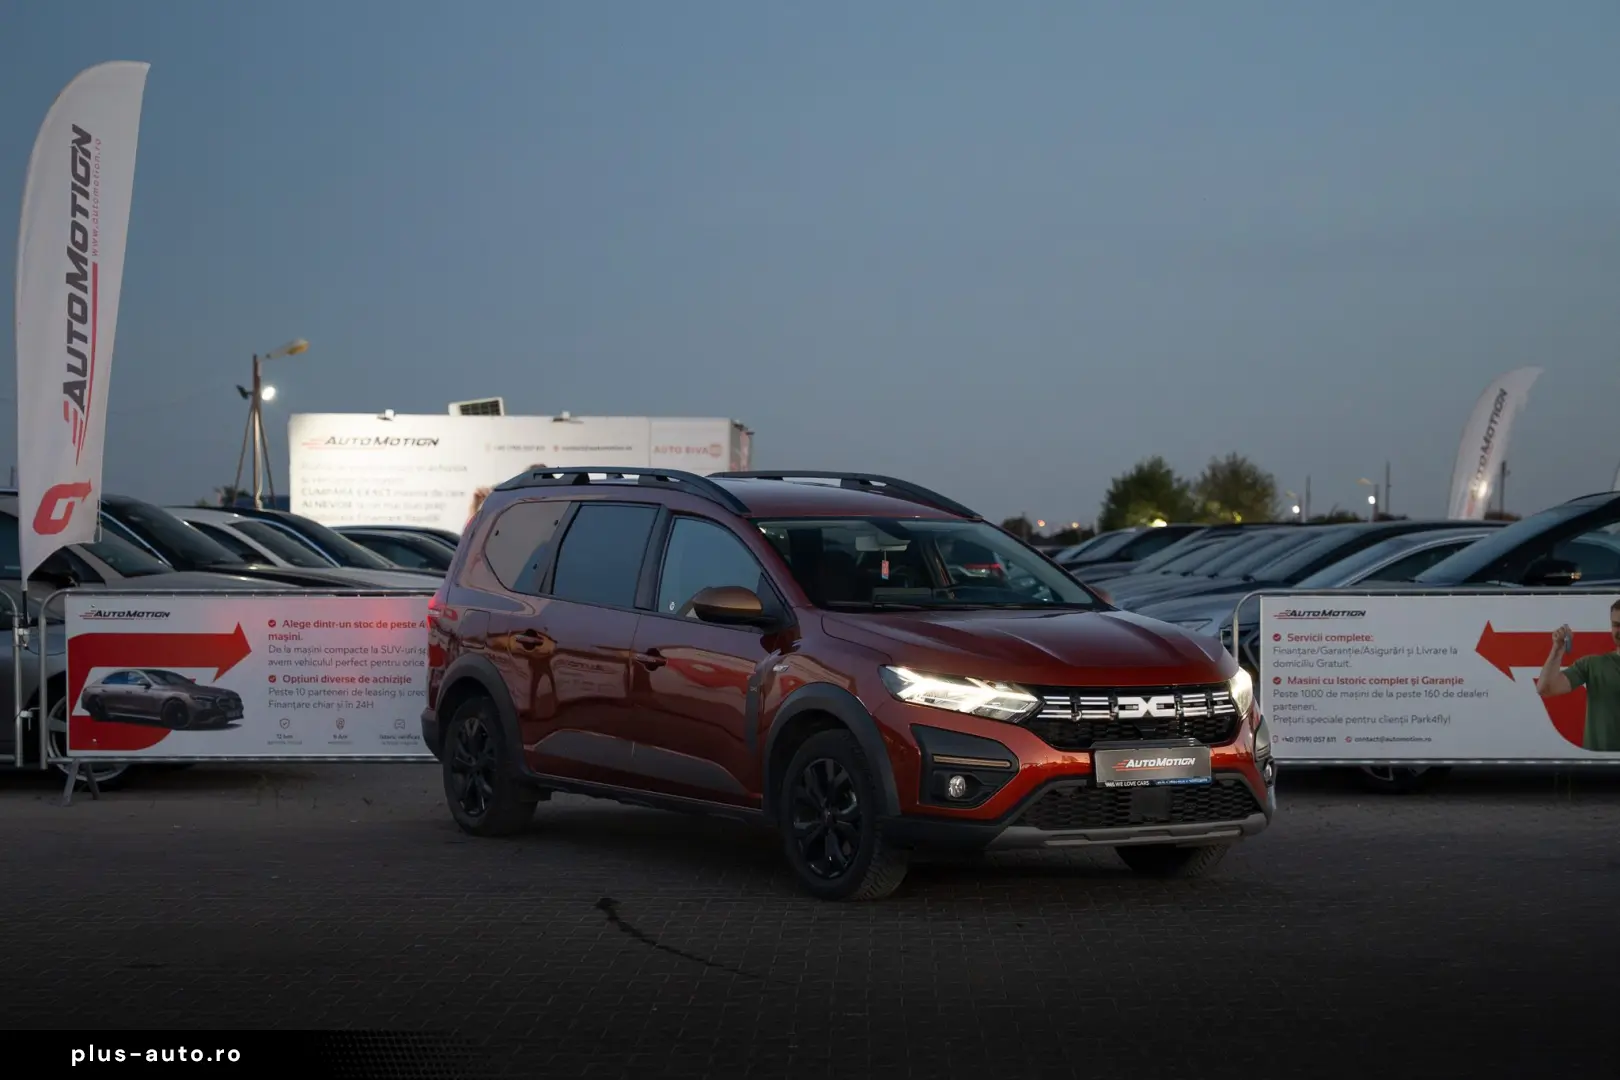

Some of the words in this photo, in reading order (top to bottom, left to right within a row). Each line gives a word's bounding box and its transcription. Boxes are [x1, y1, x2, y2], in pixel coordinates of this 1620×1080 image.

[92, 138, 102, 257] www.automotion.ro
[282, 619, 311, 631] Alege
[313, 619, 352, 629] dintr-un
[354, 620, 374, 629] stoc
[376, 619, 388, 629] de
[390, 620, 417, 631] peste
[268, 631, 303, 643] mașini.
[1287, 633, 1323, 643] Servicii
[1325, 633, 1375, 645] complete:
[268, 644, 282, 654] De
[284, 644, 292, 654] la
[293, 645, 322, 657] mașini
[324, 645, 369, 657] compacte
[370, 644, 378, 654] la
[381, 644, 417, 654] SUV-uri
[1407, 646, 1414, 658] și
[1416, 646, 1448, 656] Livrare
[1450, 646, 1458, 655] la
[268, 659, 292, 667] avem
[294, 657, 333, 667] vehiculul
[335, 657, 368, 669] perfect
[370, 658, 401, 669] pentru
[402, 657, 425, 667] orice
[1272, 659, 1314, 669] domiciliu
[1316, 659, 1352, 669] Gratuit.
[282, 674, 319, 685] Opțiuni
[320, 674, 356, 684] diverse
[358, 674, 370, 684] de
[372, 674, 412, 685] achiziție
[1322, 678, 1335, 686] cu
[1336, 676, 1367, 686] Istoric
[1368, 676, 1409, 688] complet
[1411, 676, 1419, 688] și
[1421, 676, 1465, 688] Garanție
[268, 688, 294, 697] Peste
[295, 688, 306, 697] 10
[307, 688, 349, 699] parteneri
[351, 688, 363, 697] de
[365, 688, 396, 699] leasing
[398, 688, 406, 698] și
[1272, 689, 1299, 699] Peste
[1300, 689, 1324, 699] 1000
[1325, 689, 1339, 699] de
[1340, 689, 1370, 701] mașini
[1371, 689, 1384, 699] de
[1385, 689, 1394, 699] la
[1395, 690, 1422, 700] peste
[1423, 689, 1440, 699] 160
[1441, 689, 1455, 699] de
[1456, 689, 1489, 699] dealeri
[268, 700, 311, 711] Finanțare
[312, 700, 335, 709] chiar
[337, 700, 344, 711] și
[345, 700, 354, 709] în
[355, 700, 374, 709] 24H
[1272, 702, 1318, 713] parteneri.
[1272, 715, 1305, 726] Prețuri
[1306, 715, 1344, 726] speciale
[1345, 715, 1377, 726] pentru
[1378, 714, 1409, 726] clienții
[1411, 714, 1451, 726] Park4fly!
